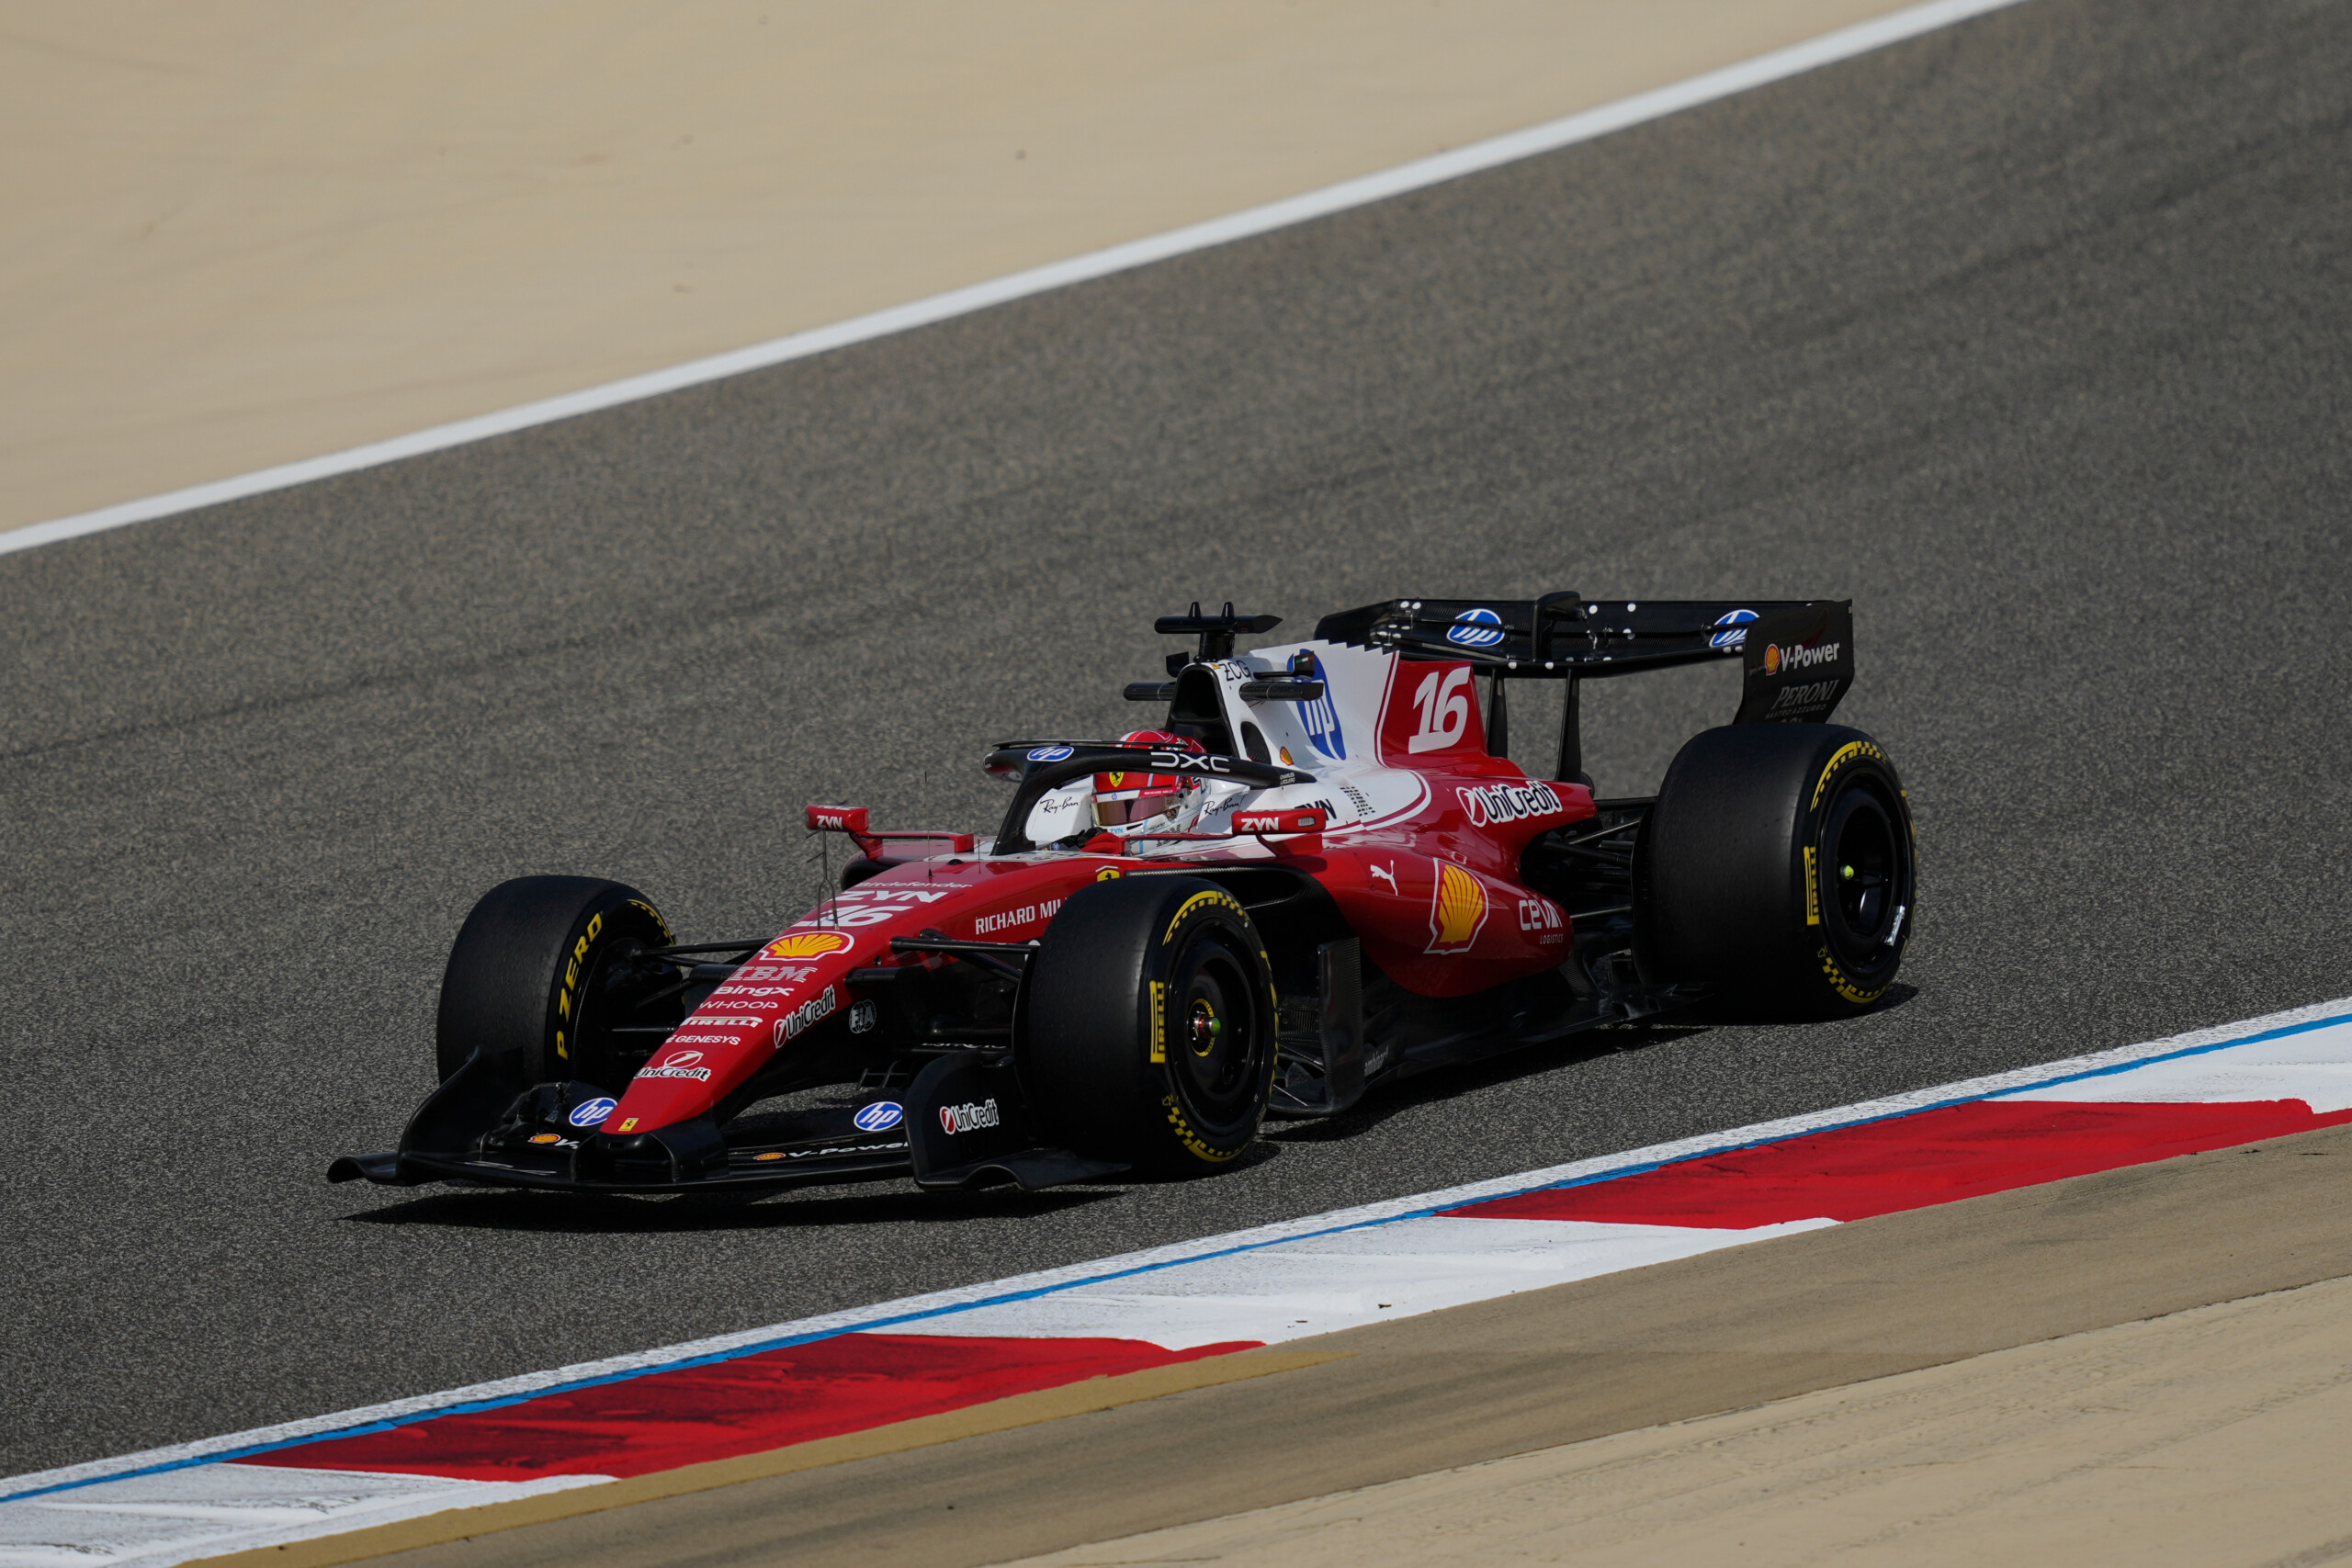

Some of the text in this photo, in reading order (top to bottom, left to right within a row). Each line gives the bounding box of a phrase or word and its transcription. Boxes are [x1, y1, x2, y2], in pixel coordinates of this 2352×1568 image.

[1780, 642, 1840, 672] V-Power
[1220, 660, 1250, 681] ZCG
[1771, 680, 1839, 710] PERONI
[1408, 666, 1470, 754] 16
[1029, 746, 1072, 761] hp
[1150, 751, 1230, 773] DXC
[1040, 796, 1079, 813] Ray-Ban
[1204, 796, 1240, 816] Ray-Ban
[1473, 781, 1563, 823] UniCredit
[817, 815, 843, 829] ZYN
[1241, 817, 1279, 831] ZYN
[826, 890, 949, 903] ZYN
[1804, 846, 1820, 926] PIRELLI
[975, 906, 1035, 935] RICHARD
[1540, 934, 1563, 944] LOGISTICS
[557, 912, 603, 1060] P ZERO
[725, 966, 818, 983] IBM
[680, 1016, 763, 1028] PIRELLI
[786, 984, 836, 1039] UniCredit
[851, 1004, 875, 1029] FIA
[1149, 980, 1165, 1063] PIRELLI
[675, 1035, 741, 1045] GENESYS
[634, 1066, 711, 1082] UniCredit
[571, 1097, 615, 1125] hp
[858, 1101, 900, 1130] hp
[951, 1098, 1000, 1132] UniCredit
